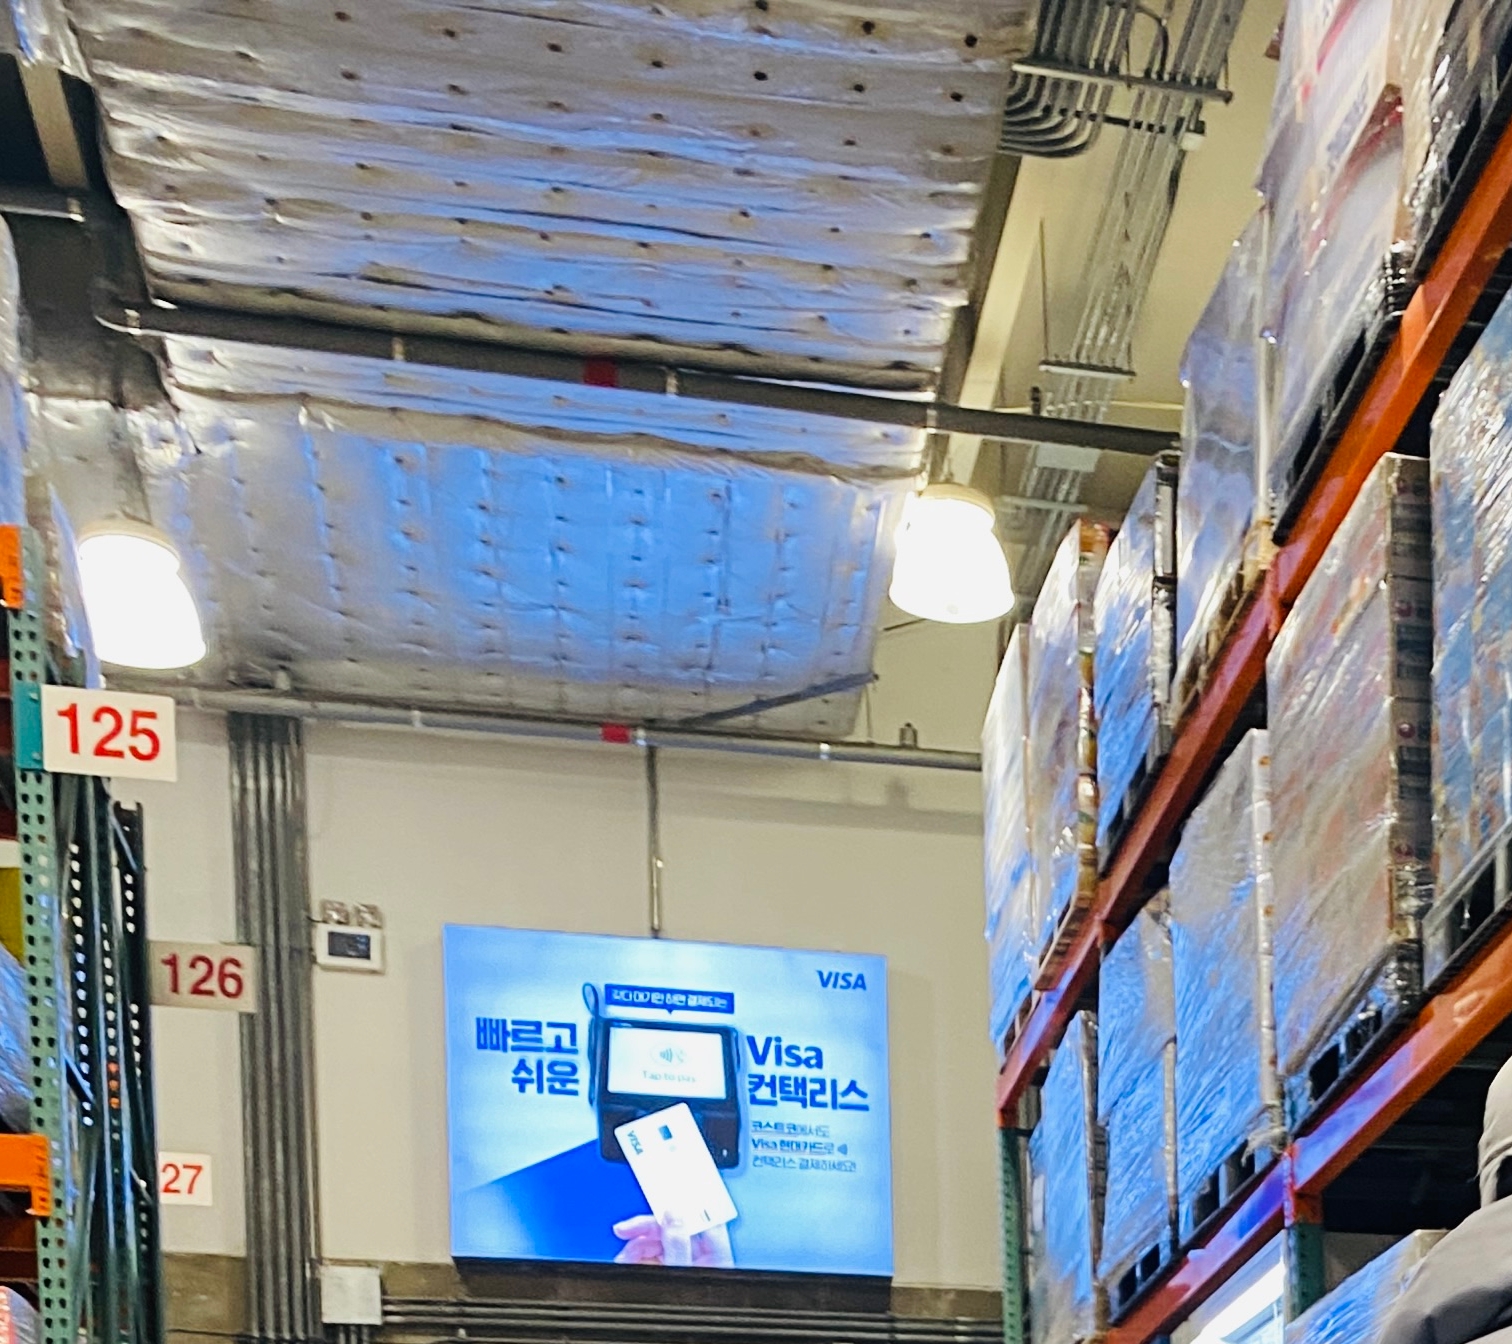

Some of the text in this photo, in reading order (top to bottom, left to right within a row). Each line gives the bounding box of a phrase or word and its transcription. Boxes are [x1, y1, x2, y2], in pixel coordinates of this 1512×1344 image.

[57, 703, 162, 762] 125
[160, 954, 245, 999] 126
[816, 970, 867, 991] VISA
[476, 1017, 579, 1055] 빠르고
[746, 1035, 824, 1069] Visa
[511, 1058, 579, 1096] 쉬운
[748, 1073, 870, 1112] 컨택리스
[751, 1139, 777, 1151] Visa
[161, 1163, 203, 1194] 27
